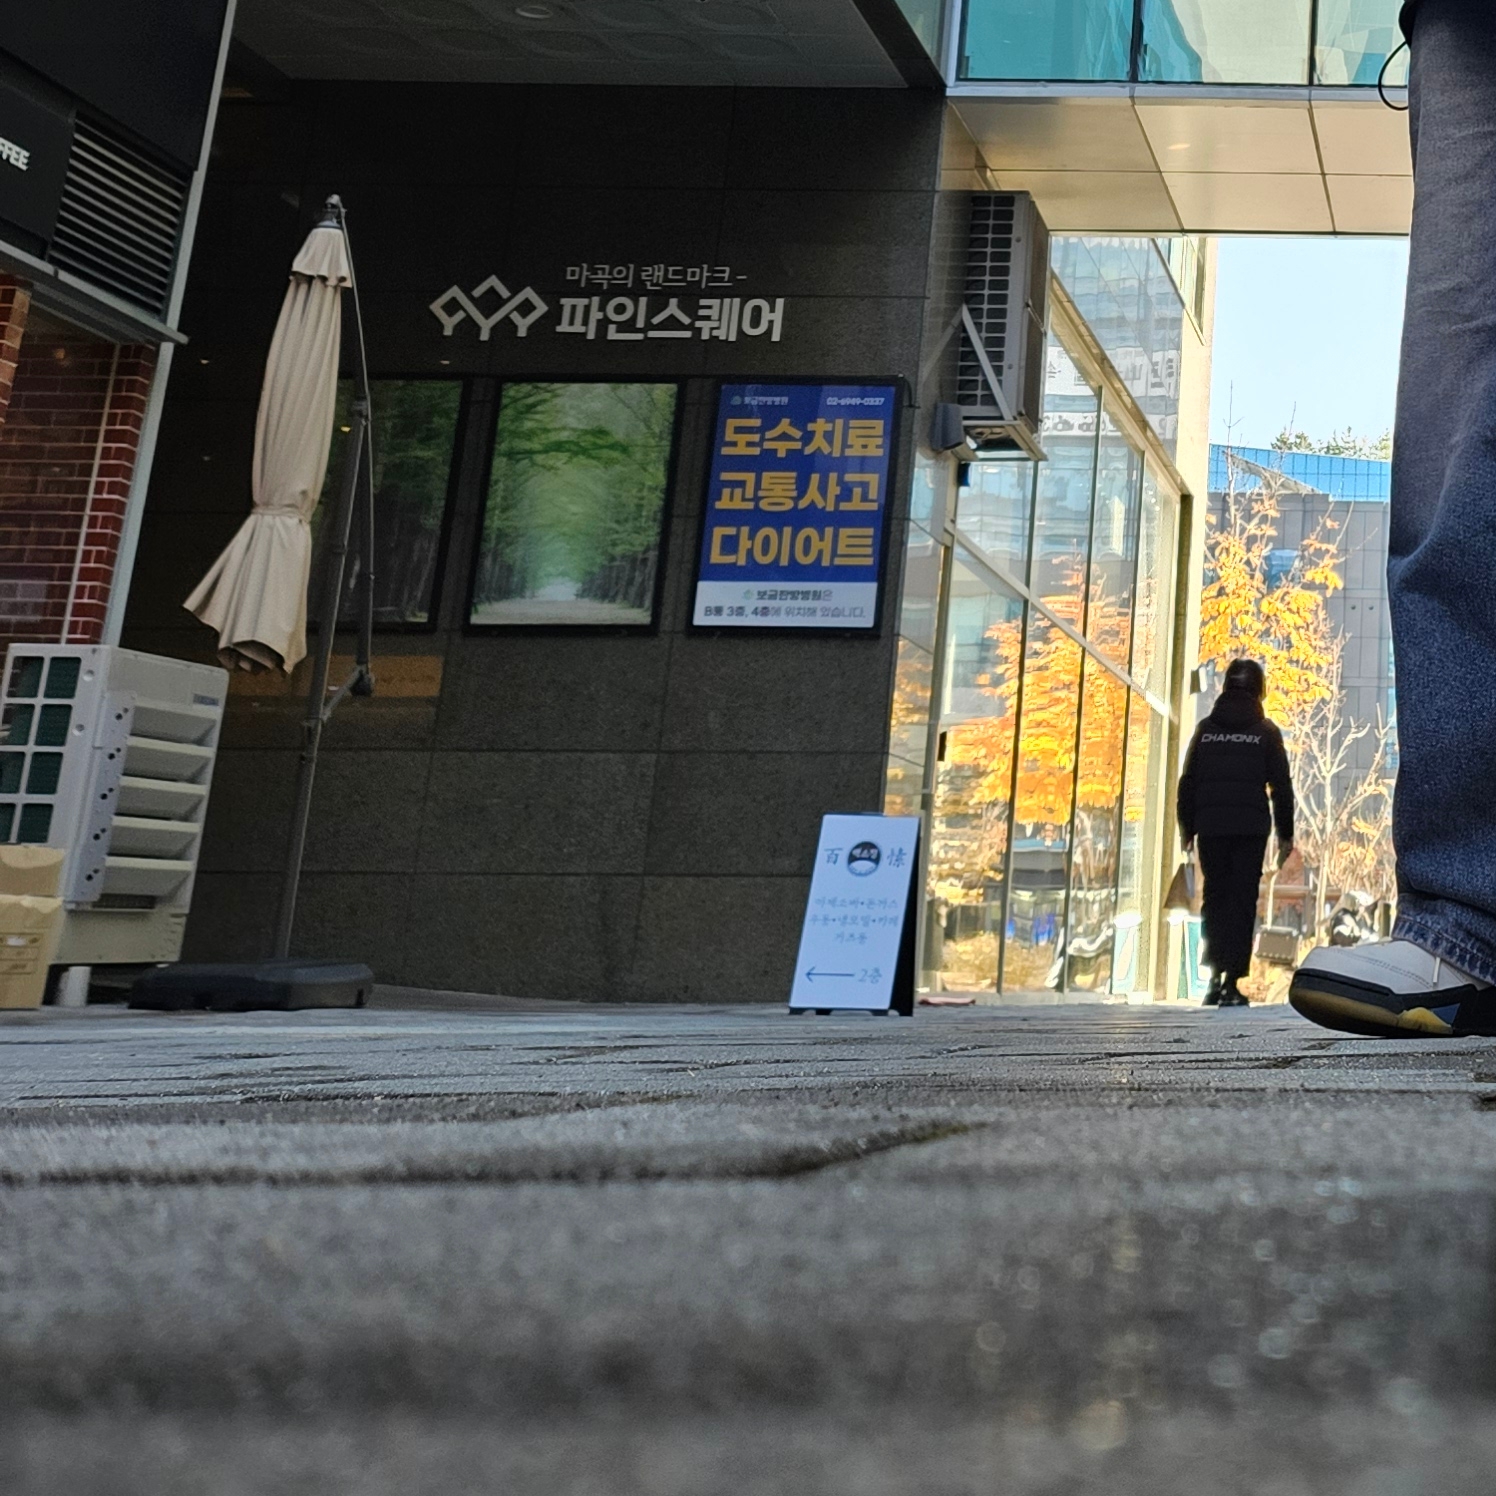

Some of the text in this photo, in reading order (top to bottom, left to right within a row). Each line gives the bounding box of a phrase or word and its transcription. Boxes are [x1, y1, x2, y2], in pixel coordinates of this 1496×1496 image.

[566, 263, 635, 290] 마곡의
[555, 296, 785, 342] 파인스퀘어
[720, 417, 885, 458] 도수치료
[714, 471, 880, 513] 교통사고
[709, 525, 875, 568] 다이어트
[1201, 733, 1262, 745] CHAMONIX
